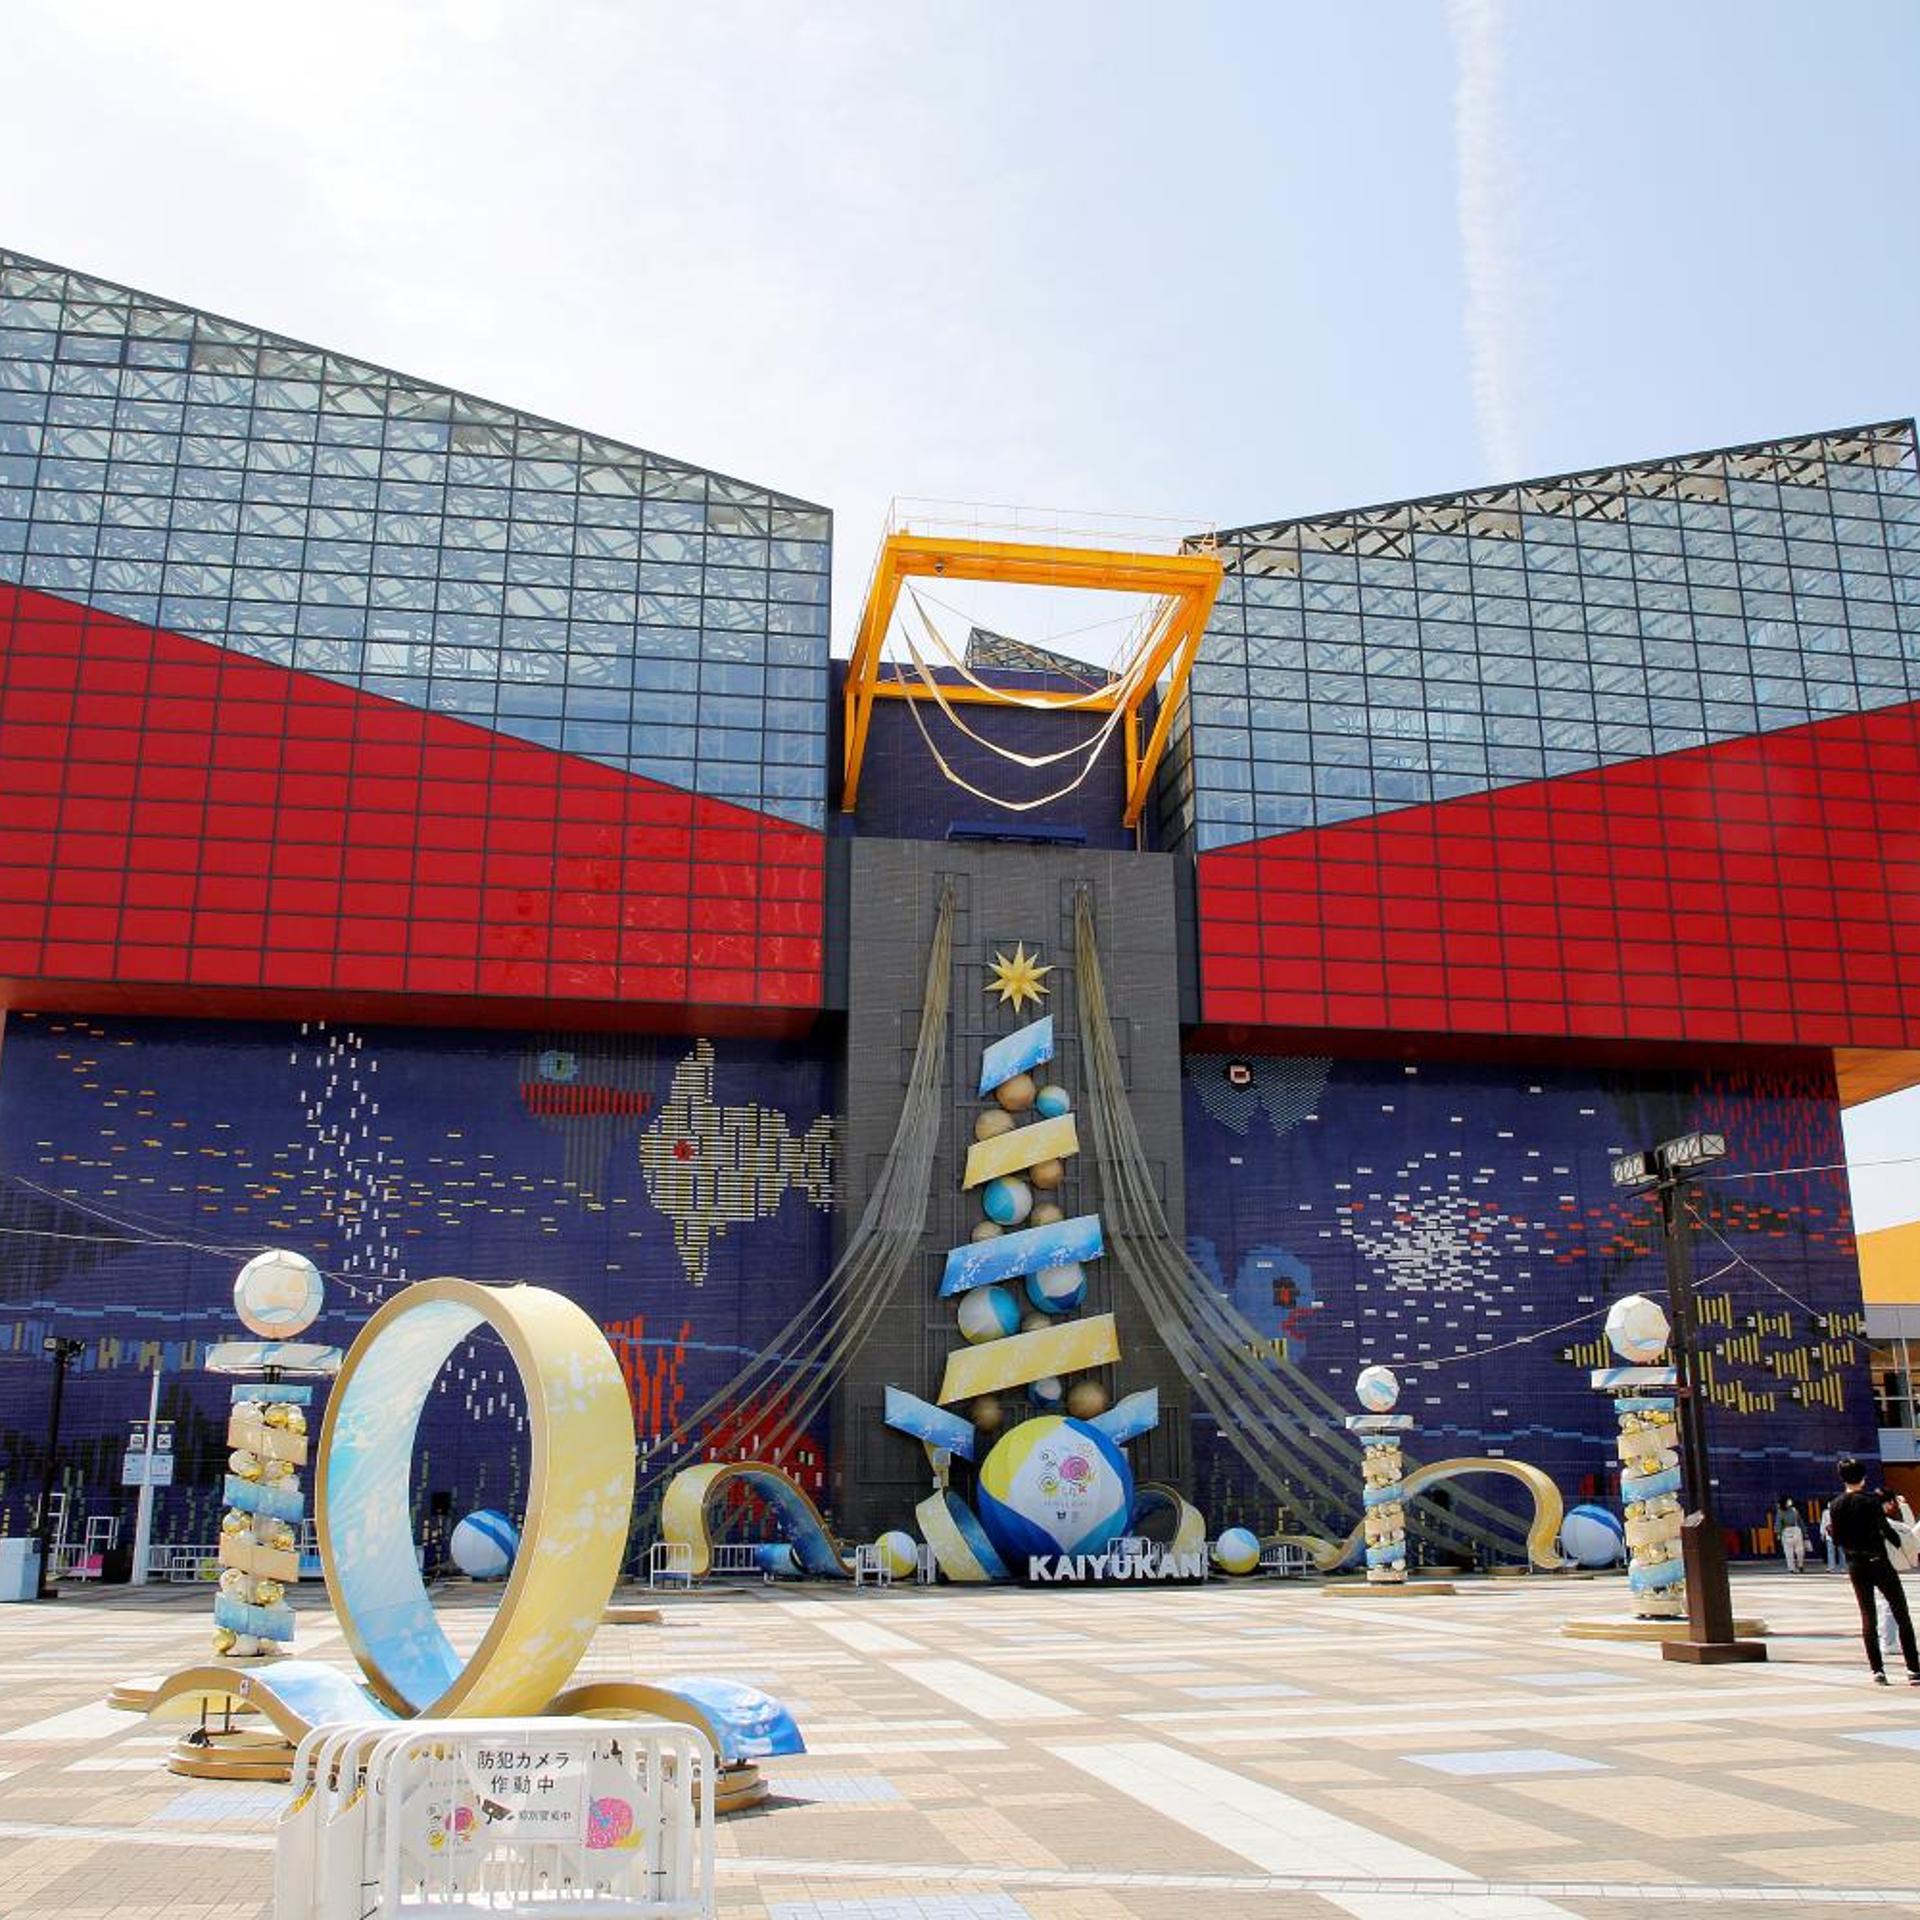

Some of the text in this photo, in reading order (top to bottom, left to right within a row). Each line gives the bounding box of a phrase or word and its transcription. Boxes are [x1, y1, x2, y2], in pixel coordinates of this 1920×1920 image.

[1029, 1555, 1202, 1581] KAIYUKAN
[478, 1750, 569, 1769] 防犯カメラ
[491, 1775, 554, 1794] 作動中
